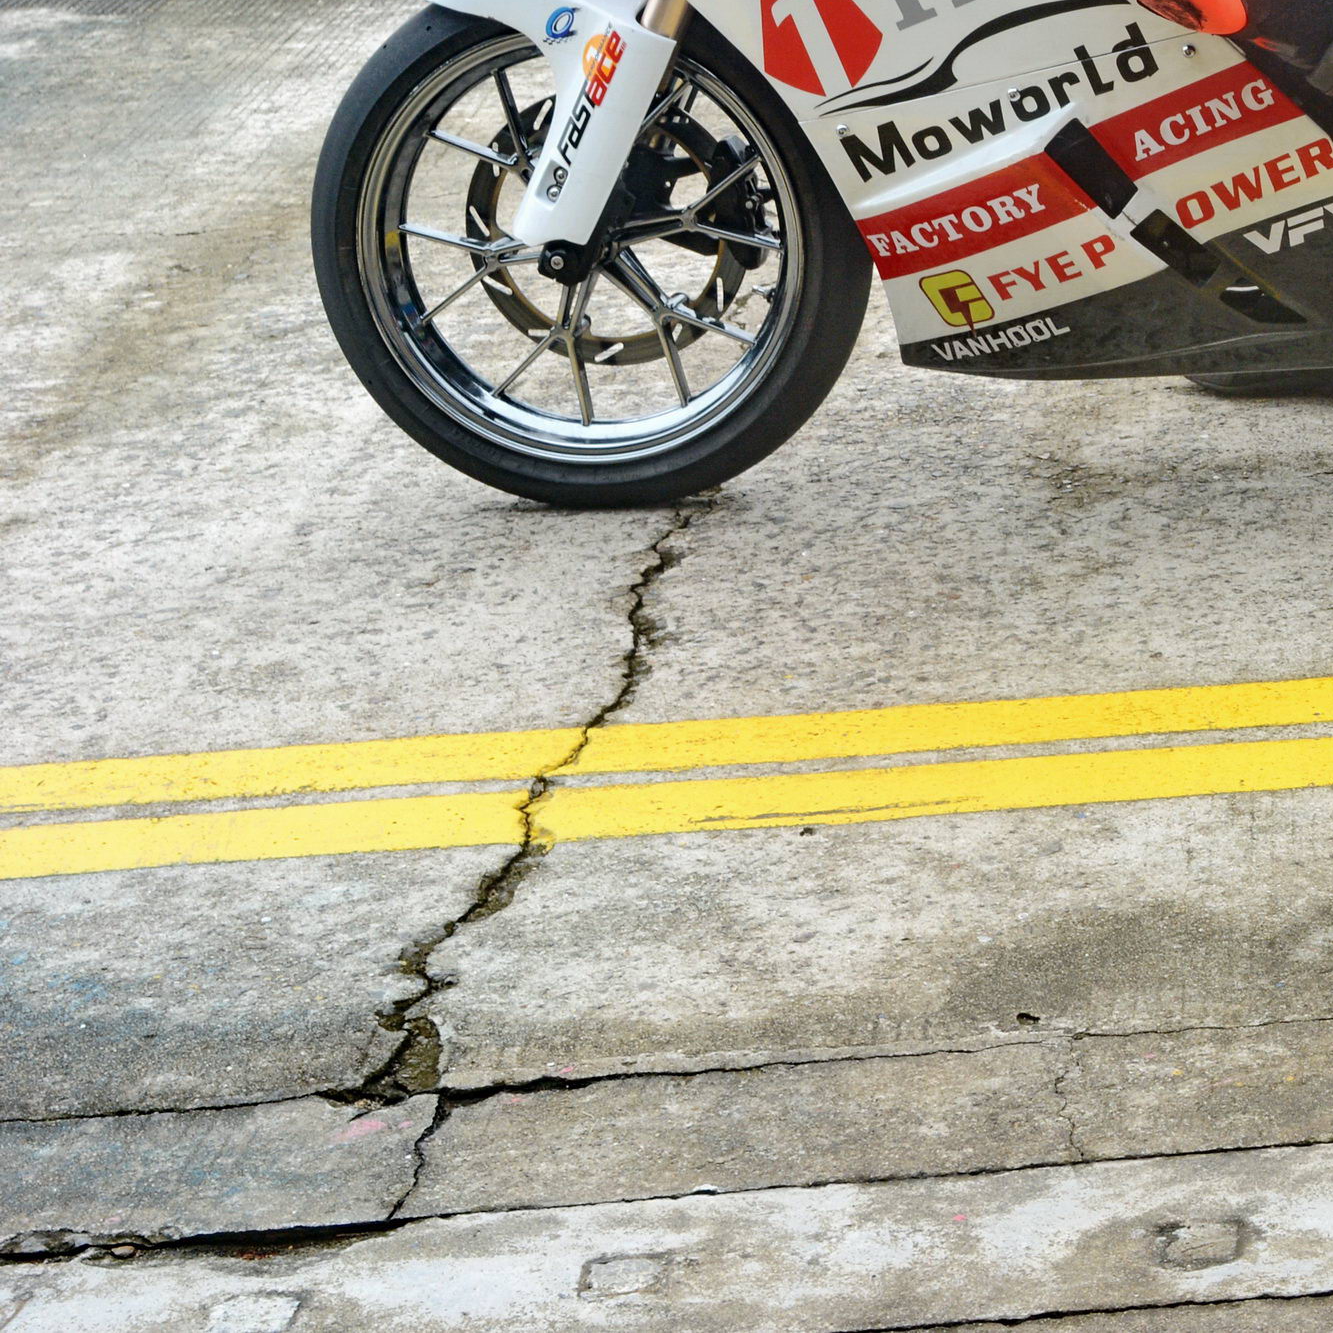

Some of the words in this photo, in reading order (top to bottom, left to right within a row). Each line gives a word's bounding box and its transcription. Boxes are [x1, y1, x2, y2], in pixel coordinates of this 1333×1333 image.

[841, 22, 1159, 183] Moworld
[866, 183, 1046, 258] FACTORY
[992, 249, 1085, 303] FYE
[1088, 233, 1118, 272] P
[931, 314, 1072, 364] VANHOOL
